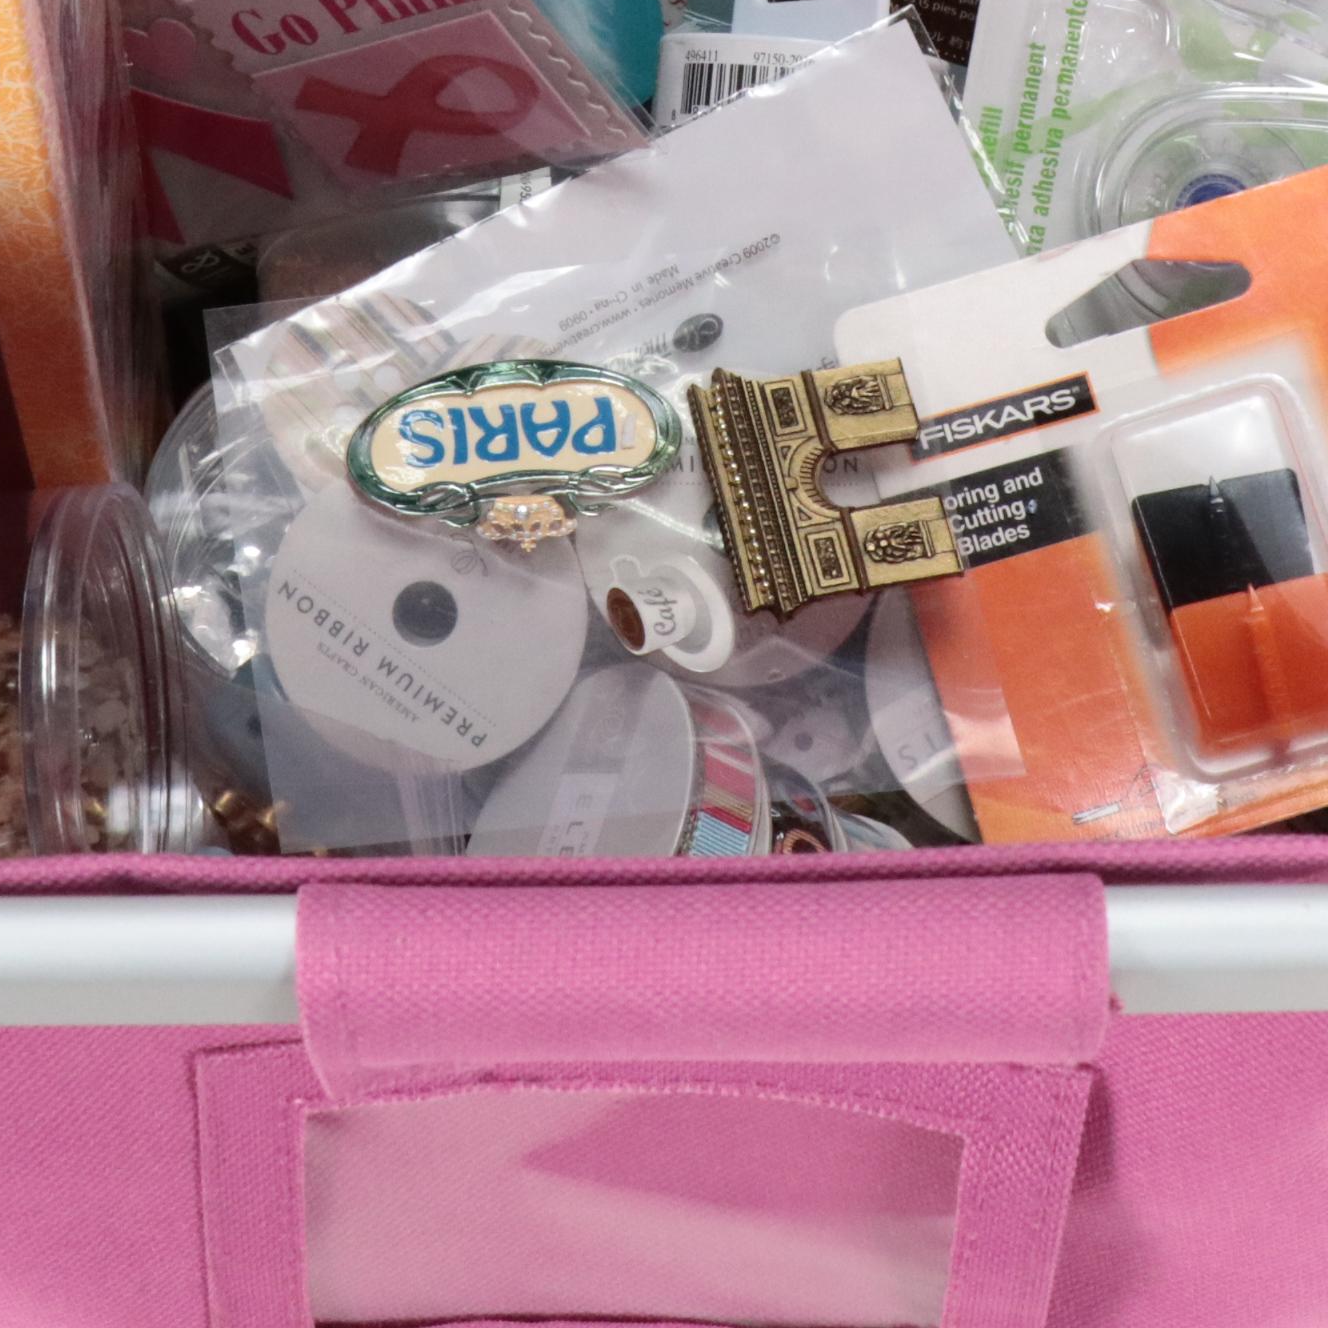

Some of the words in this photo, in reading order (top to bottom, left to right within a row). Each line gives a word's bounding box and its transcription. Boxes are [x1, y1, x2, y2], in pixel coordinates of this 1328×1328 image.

[230, 7, 320, 56] Go
[753, 51, 816, 66] 97150-20
[1013, 41, 1047, 155] permanent
[1032, 126, 1065, 217] adhesiva
[630, 280, 646, 293] in
[648, 263, 681, 286] Made
[402, 394, 619, 469] PARIS
[919, 387, 1077, 451] FISKARS
[943, 482, 1001, 511] oring
[1002, 466, 1044, 495] and
[949, 498, 1027, 534] Cutting
[957, 522, 1031, 556] Blades
[277, 580, 370, 658] RIBBON
[376, 655, 489, 748] PREMIUM
